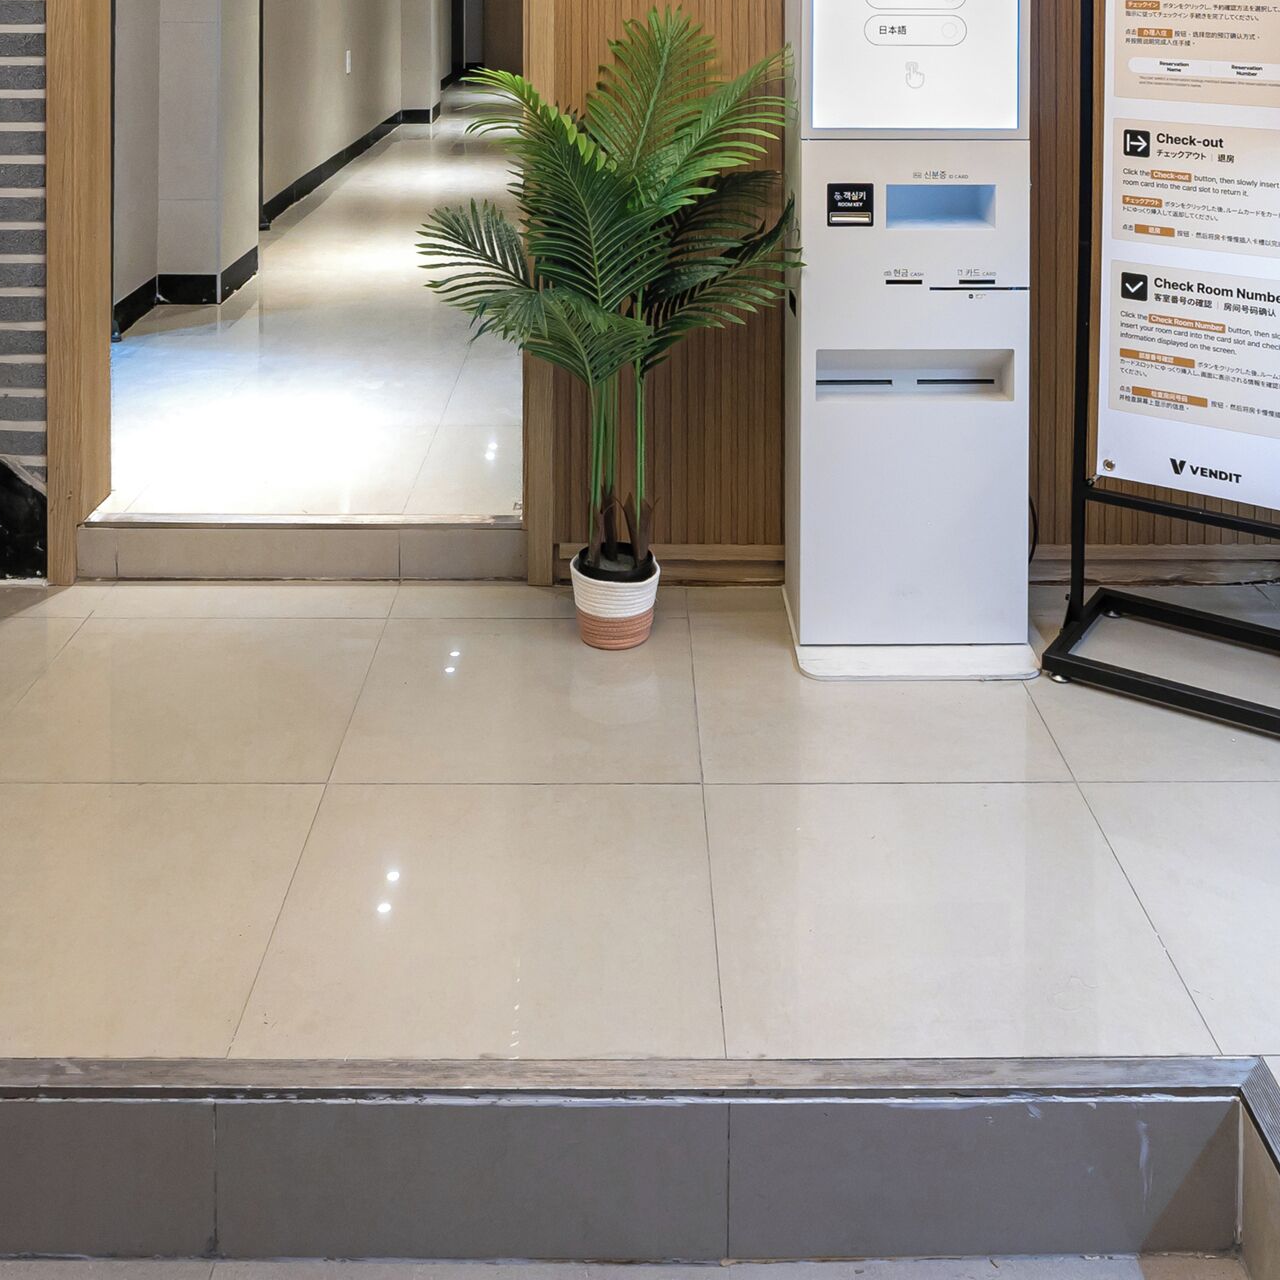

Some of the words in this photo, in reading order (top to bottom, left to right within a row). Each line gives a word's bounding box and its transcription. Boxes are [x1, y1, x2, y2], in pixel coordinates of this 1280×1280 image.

[879, 26, 907, 35] 日本語
[1156, 133, 1224, 148] Check-out
[1156, 150, 1207, 160] チェックアウト
[1217, 154, 1235, 164] 退房
[1123, 168, 1138, 176] Click
[1139, 169, 1150, 177] the
[1153, 171, 1189, 181] Check-out
[1194, 175, 1218, 184] button,
[1220, 177, 1235, 185] then
[1236, 179, 1258, 188] slowly
[1260, 181, 1279, 189] insert
[1140, 180, 1154, 188] card
[1170, 183, 1180, 191] the
[1182, 184, 1197, 192] card
[1221, 188, 1241, 196] return
[1125, 197, 1160, 206] チェックアウト
[1154, 277, 1194, 293] Check
[1197, 283, 1234, 298] Room
[1154, 293, 1213, 309] 客室番号の確認
[1223, 302, 1276, 317] 房间号码确认
[1120, 311, 1136, 319] Click
[1137, 312, 1148, 321] the
[1151, 315, 1173, 324] Check
[1174, 318, 1193, 328] Room
[1195, 321, 1224, 331] Number
[1228, 326, 1252, 337] button,
[1254, 329, 1270, 338] then
[1120, 322, 1138, 330] insert
[1139, 325, 1154, 333] your
[1155, 327, 1172, 335] room
[1173, 328, 1189, 337] card
[1189, 331, 1202, 339] into
[1204, 333, 1215, 341] the
[1216, 335, 1231, 344] card
[1233, 337, 1246, 346] slot
[1247, 339, 1261, 348] and
[1120, 332, 1156, 343] information
[1157, 337, 1188, 349] displayed
[1200, 343, 1211, 351] the
[1212, 346, 1237, 355] screen.
[1189, 464, 1242, 484] VENDIT
